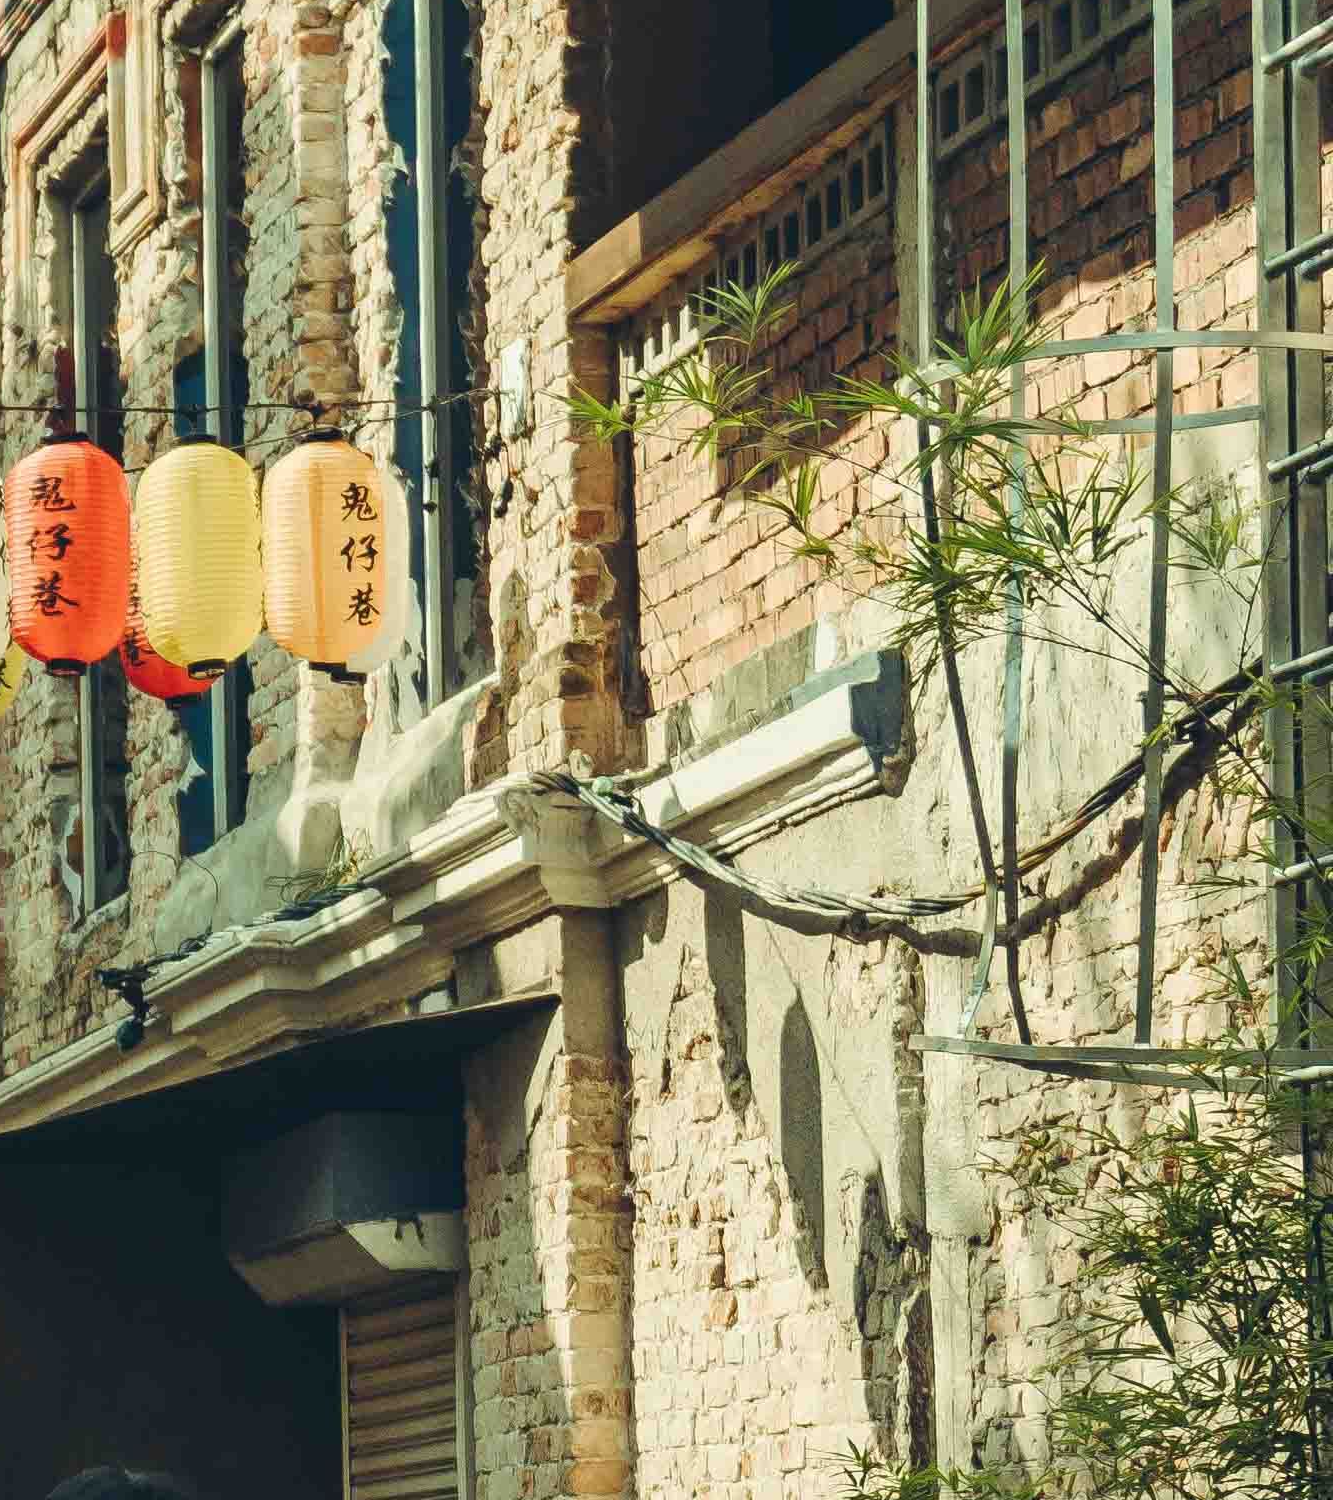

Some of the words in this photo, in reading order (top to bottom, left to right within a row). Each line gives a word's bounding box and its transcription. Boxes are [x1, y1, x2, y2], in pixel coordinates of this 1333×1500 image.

[28, 476, 81, 617] 鬼仔巷
[339, 482, 380, 627] 鬼仔巷
